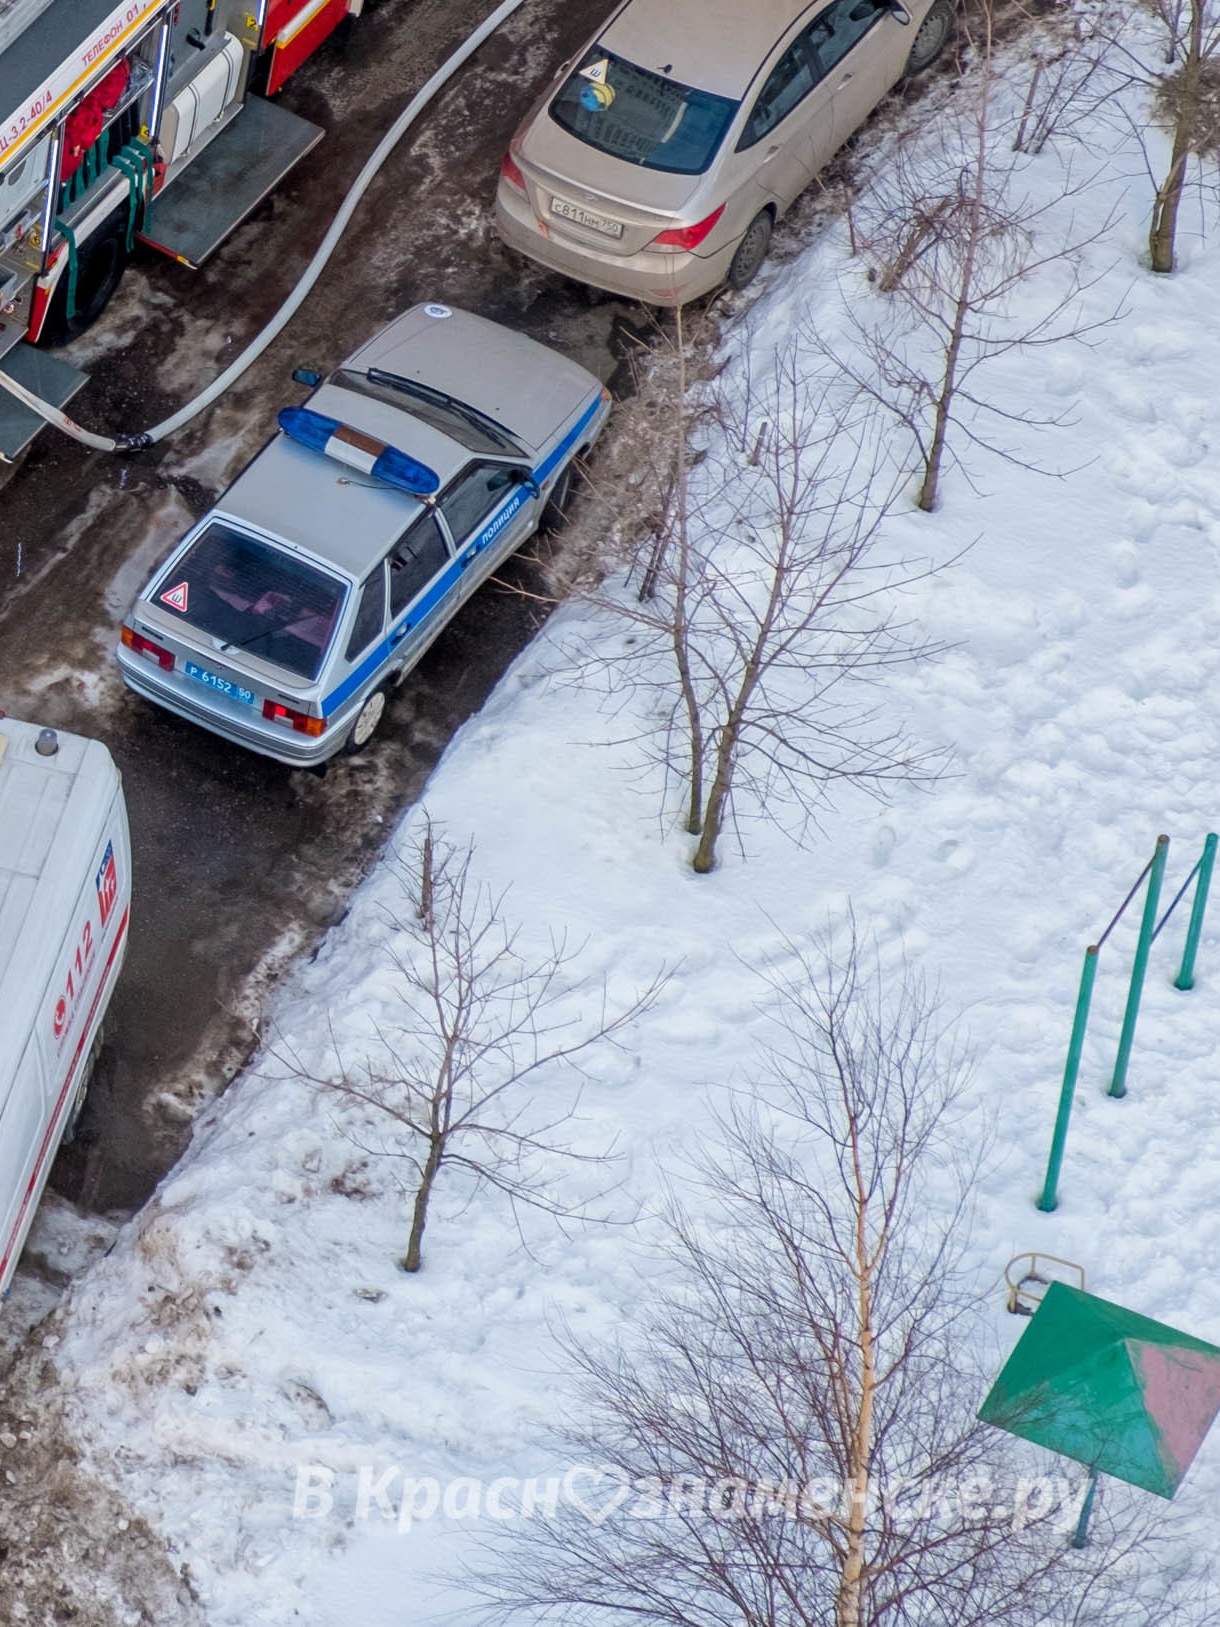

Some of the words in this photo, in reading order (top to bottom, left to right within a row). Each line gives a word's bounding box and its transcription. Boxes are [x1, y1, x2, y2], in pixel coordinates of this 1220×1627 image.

[82, 21, 123, 65] ТЕЛЕФОН
[482, 497, 520, 545] ПОЛИЦИЯ
[66, 920, 93, 1000] 112
